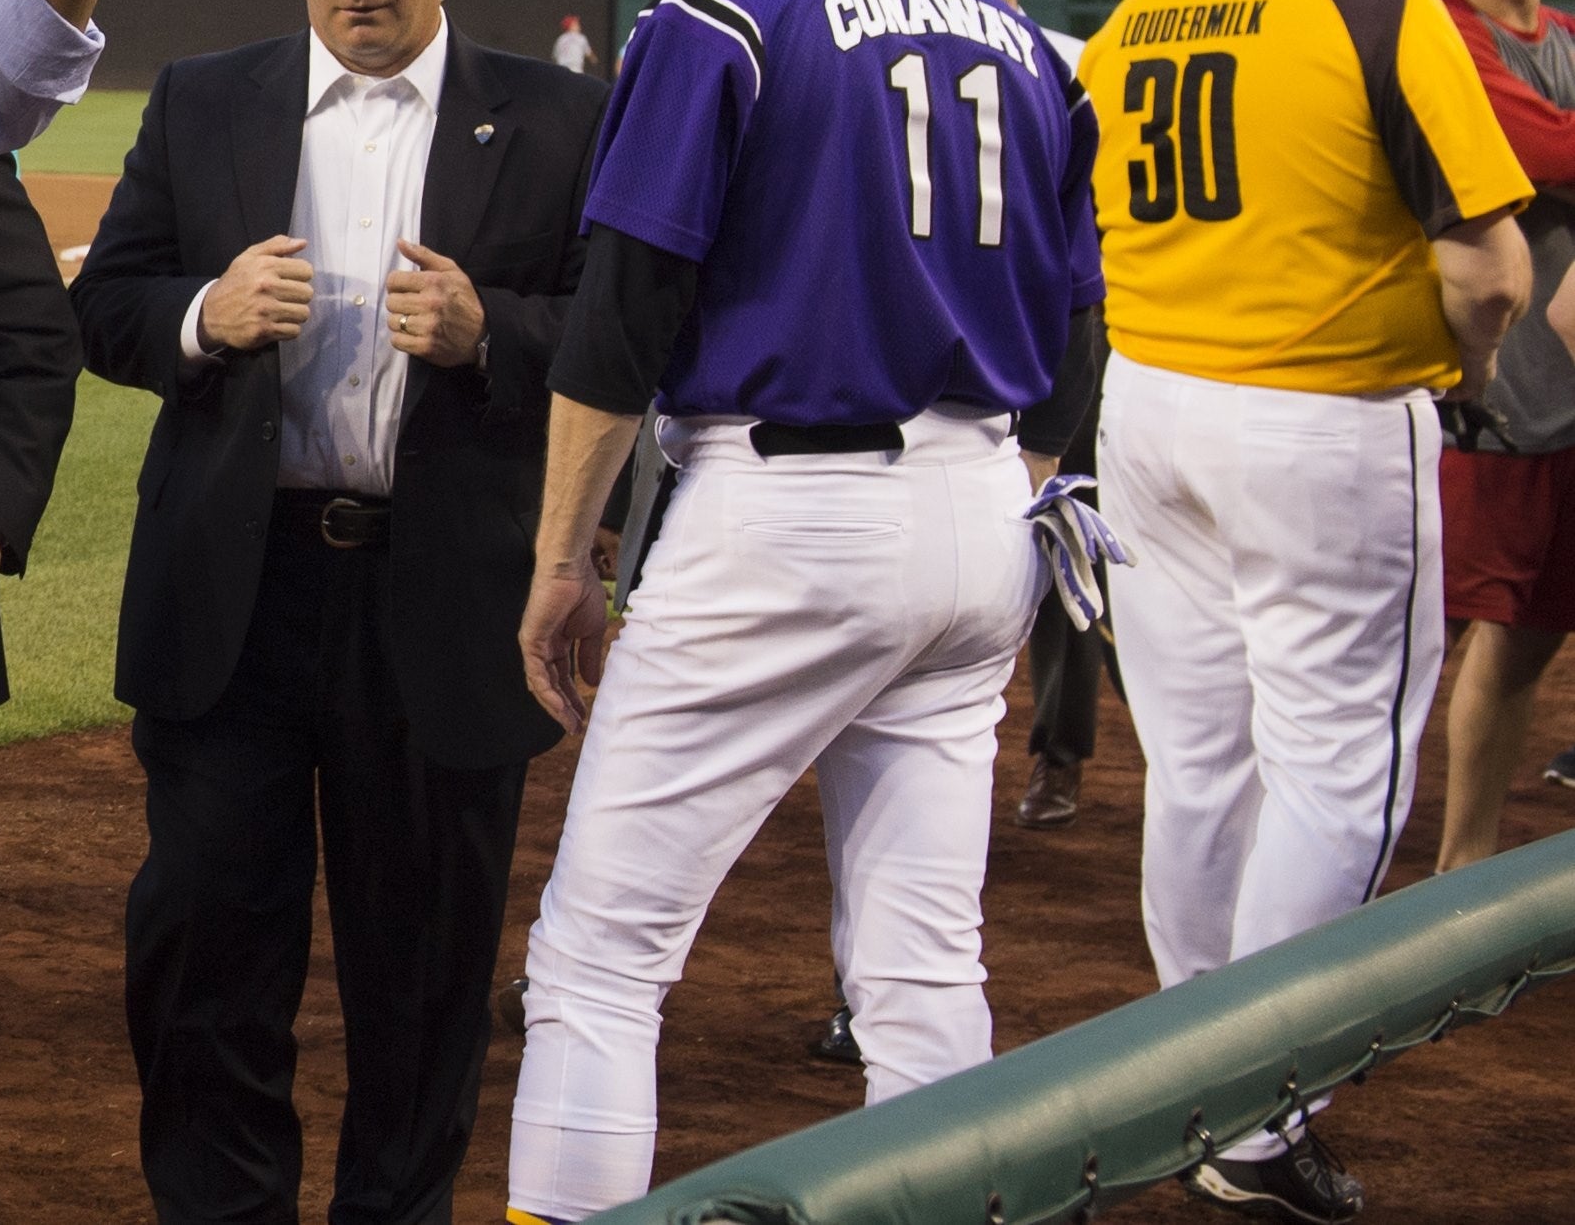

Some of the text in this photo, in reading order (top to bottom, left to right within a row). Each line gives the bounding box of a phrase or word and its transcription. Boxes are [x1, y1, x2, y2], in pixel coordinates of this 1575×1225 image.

[1120, 0, 1268, 48] LOUDERMILK
[889, 52, 1003, 247] 11
[1123, 50, 1243, 224] 30
